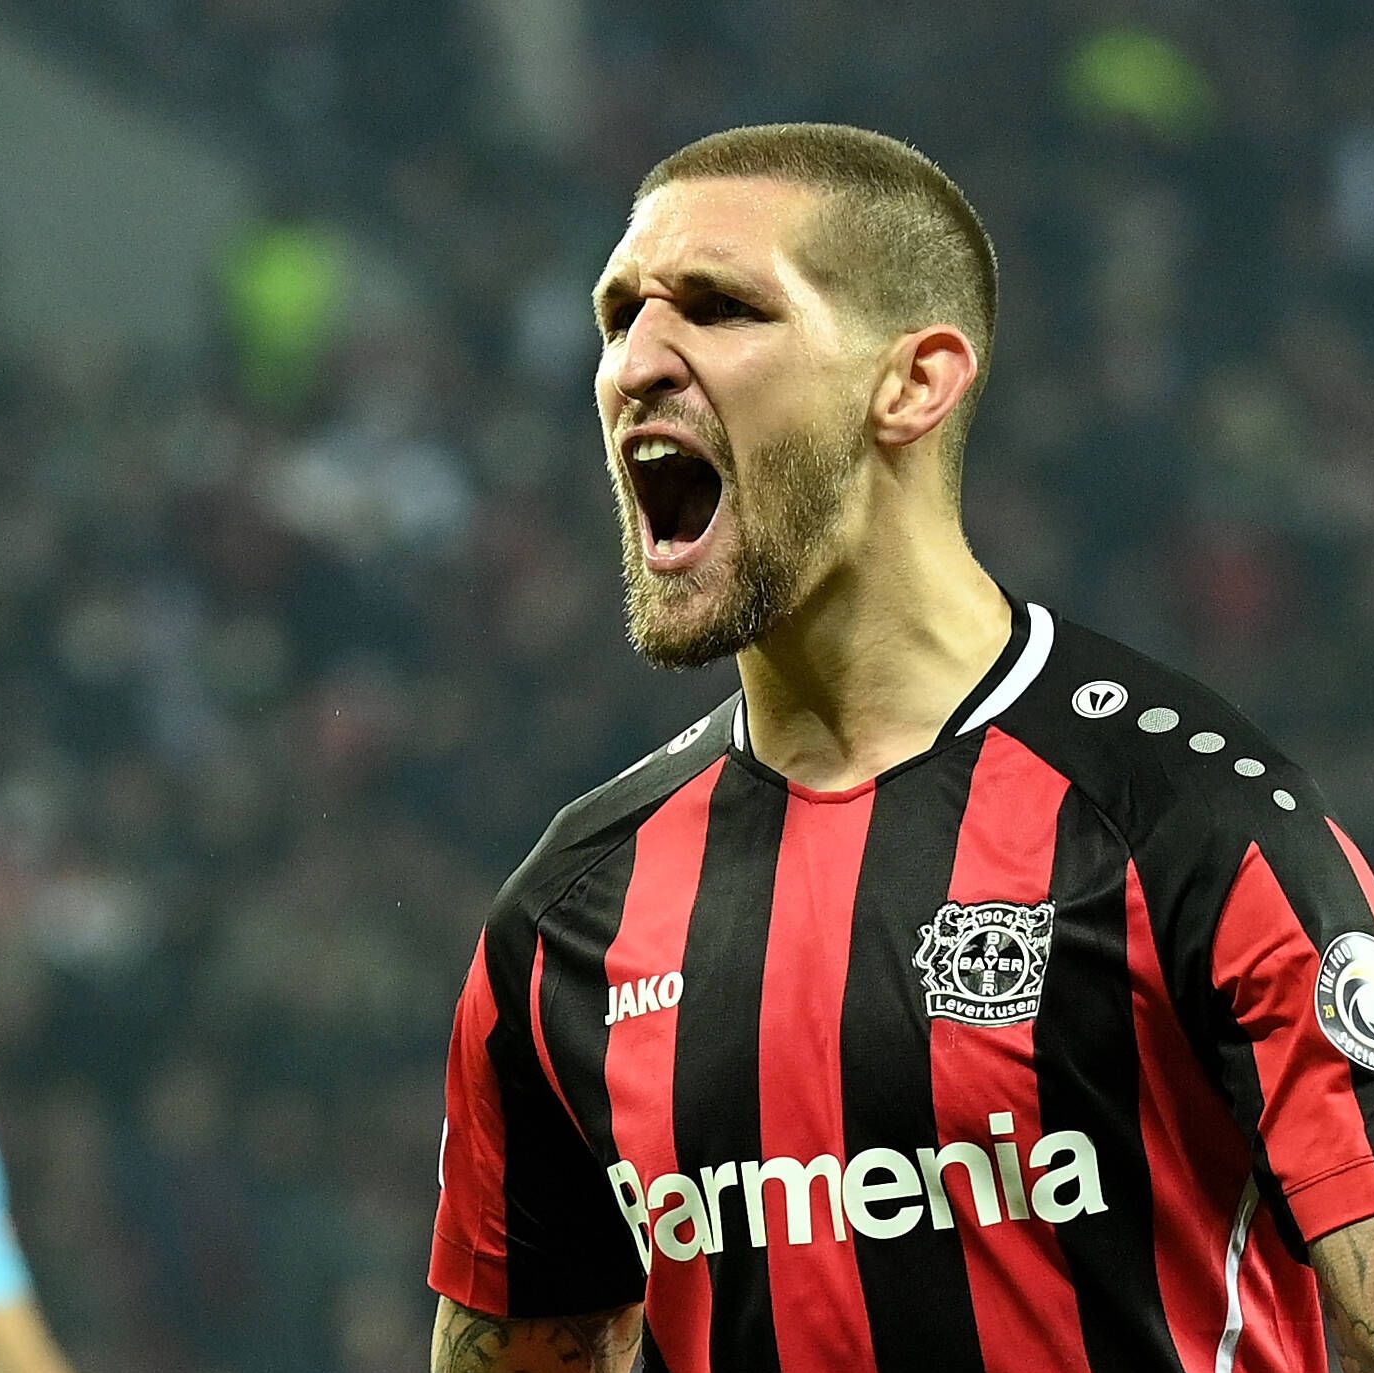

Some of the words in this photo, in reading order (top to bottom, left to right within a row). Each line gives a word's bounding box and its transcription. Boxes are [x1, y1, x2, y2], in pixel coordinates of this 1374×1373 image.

[976, 910, 1015, 926] 1904
[959, 957, 1023, 972] BAYER
[982, 931, 1000, 996] BAYER
[604, 971, 684, 1026] JAKO
[935, 995, 1037, 1018] Leverkusen
[607, 1111, 1109, 1276] Barmenia
